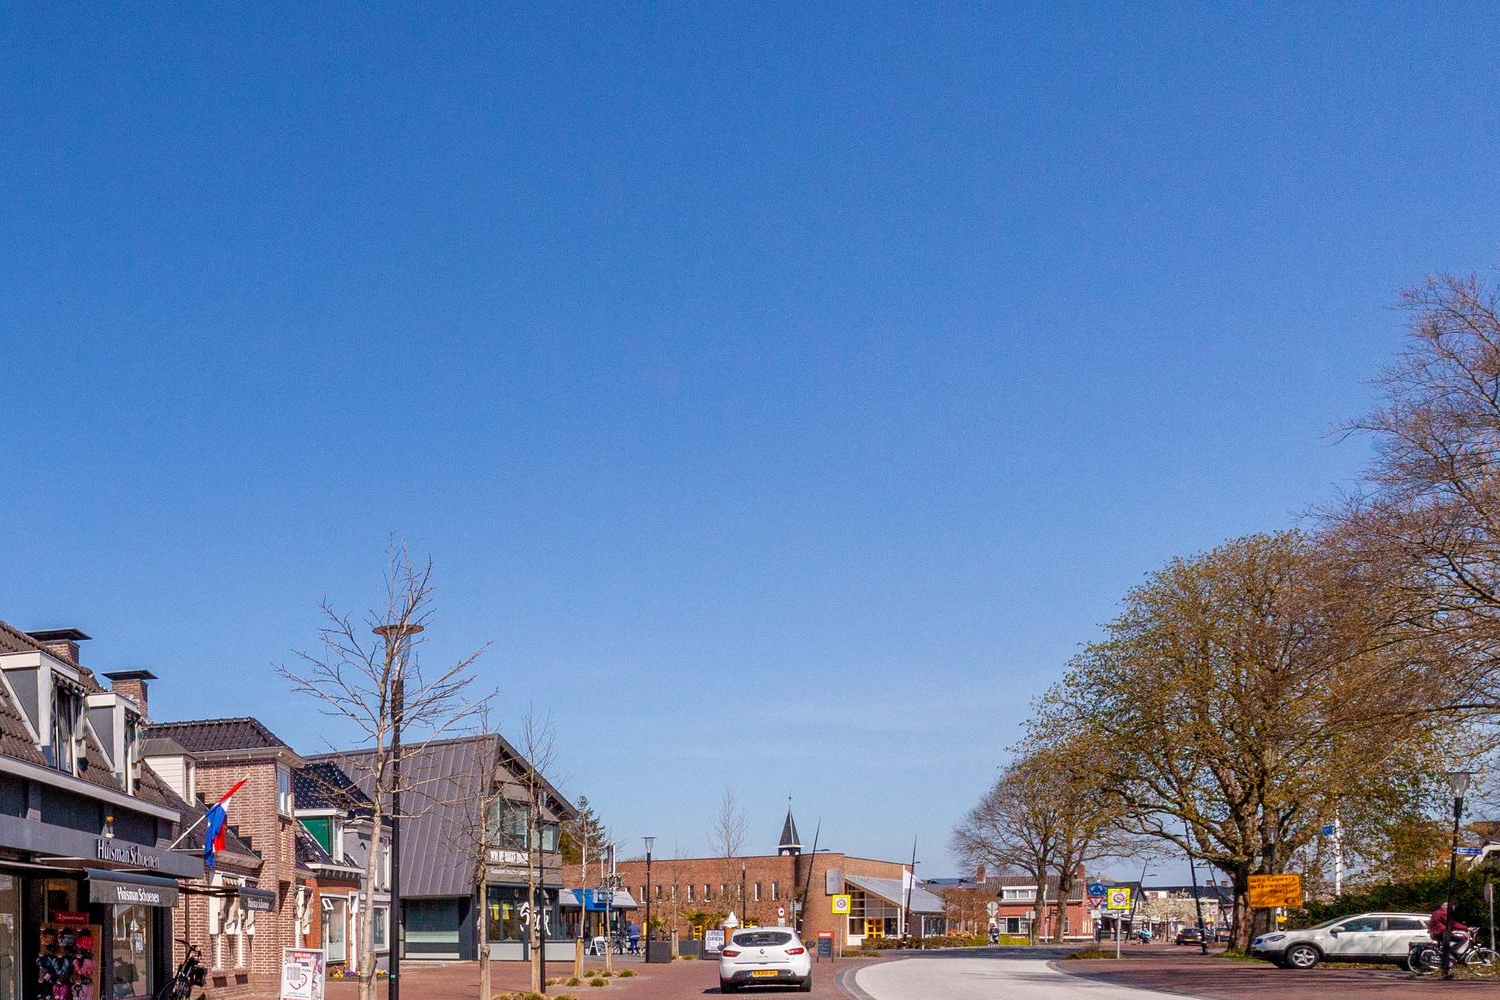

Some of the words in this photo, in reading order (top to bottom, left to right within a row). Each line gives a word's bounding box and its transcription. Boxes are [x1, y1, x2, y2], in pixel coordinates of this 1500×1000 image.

[97, 839, 130, 864] Huisman
[130, 845, 160, 869] Schoenen
[117, 886, 138, 901] Huisman
[138, 888, 160, 903] Schoenen
